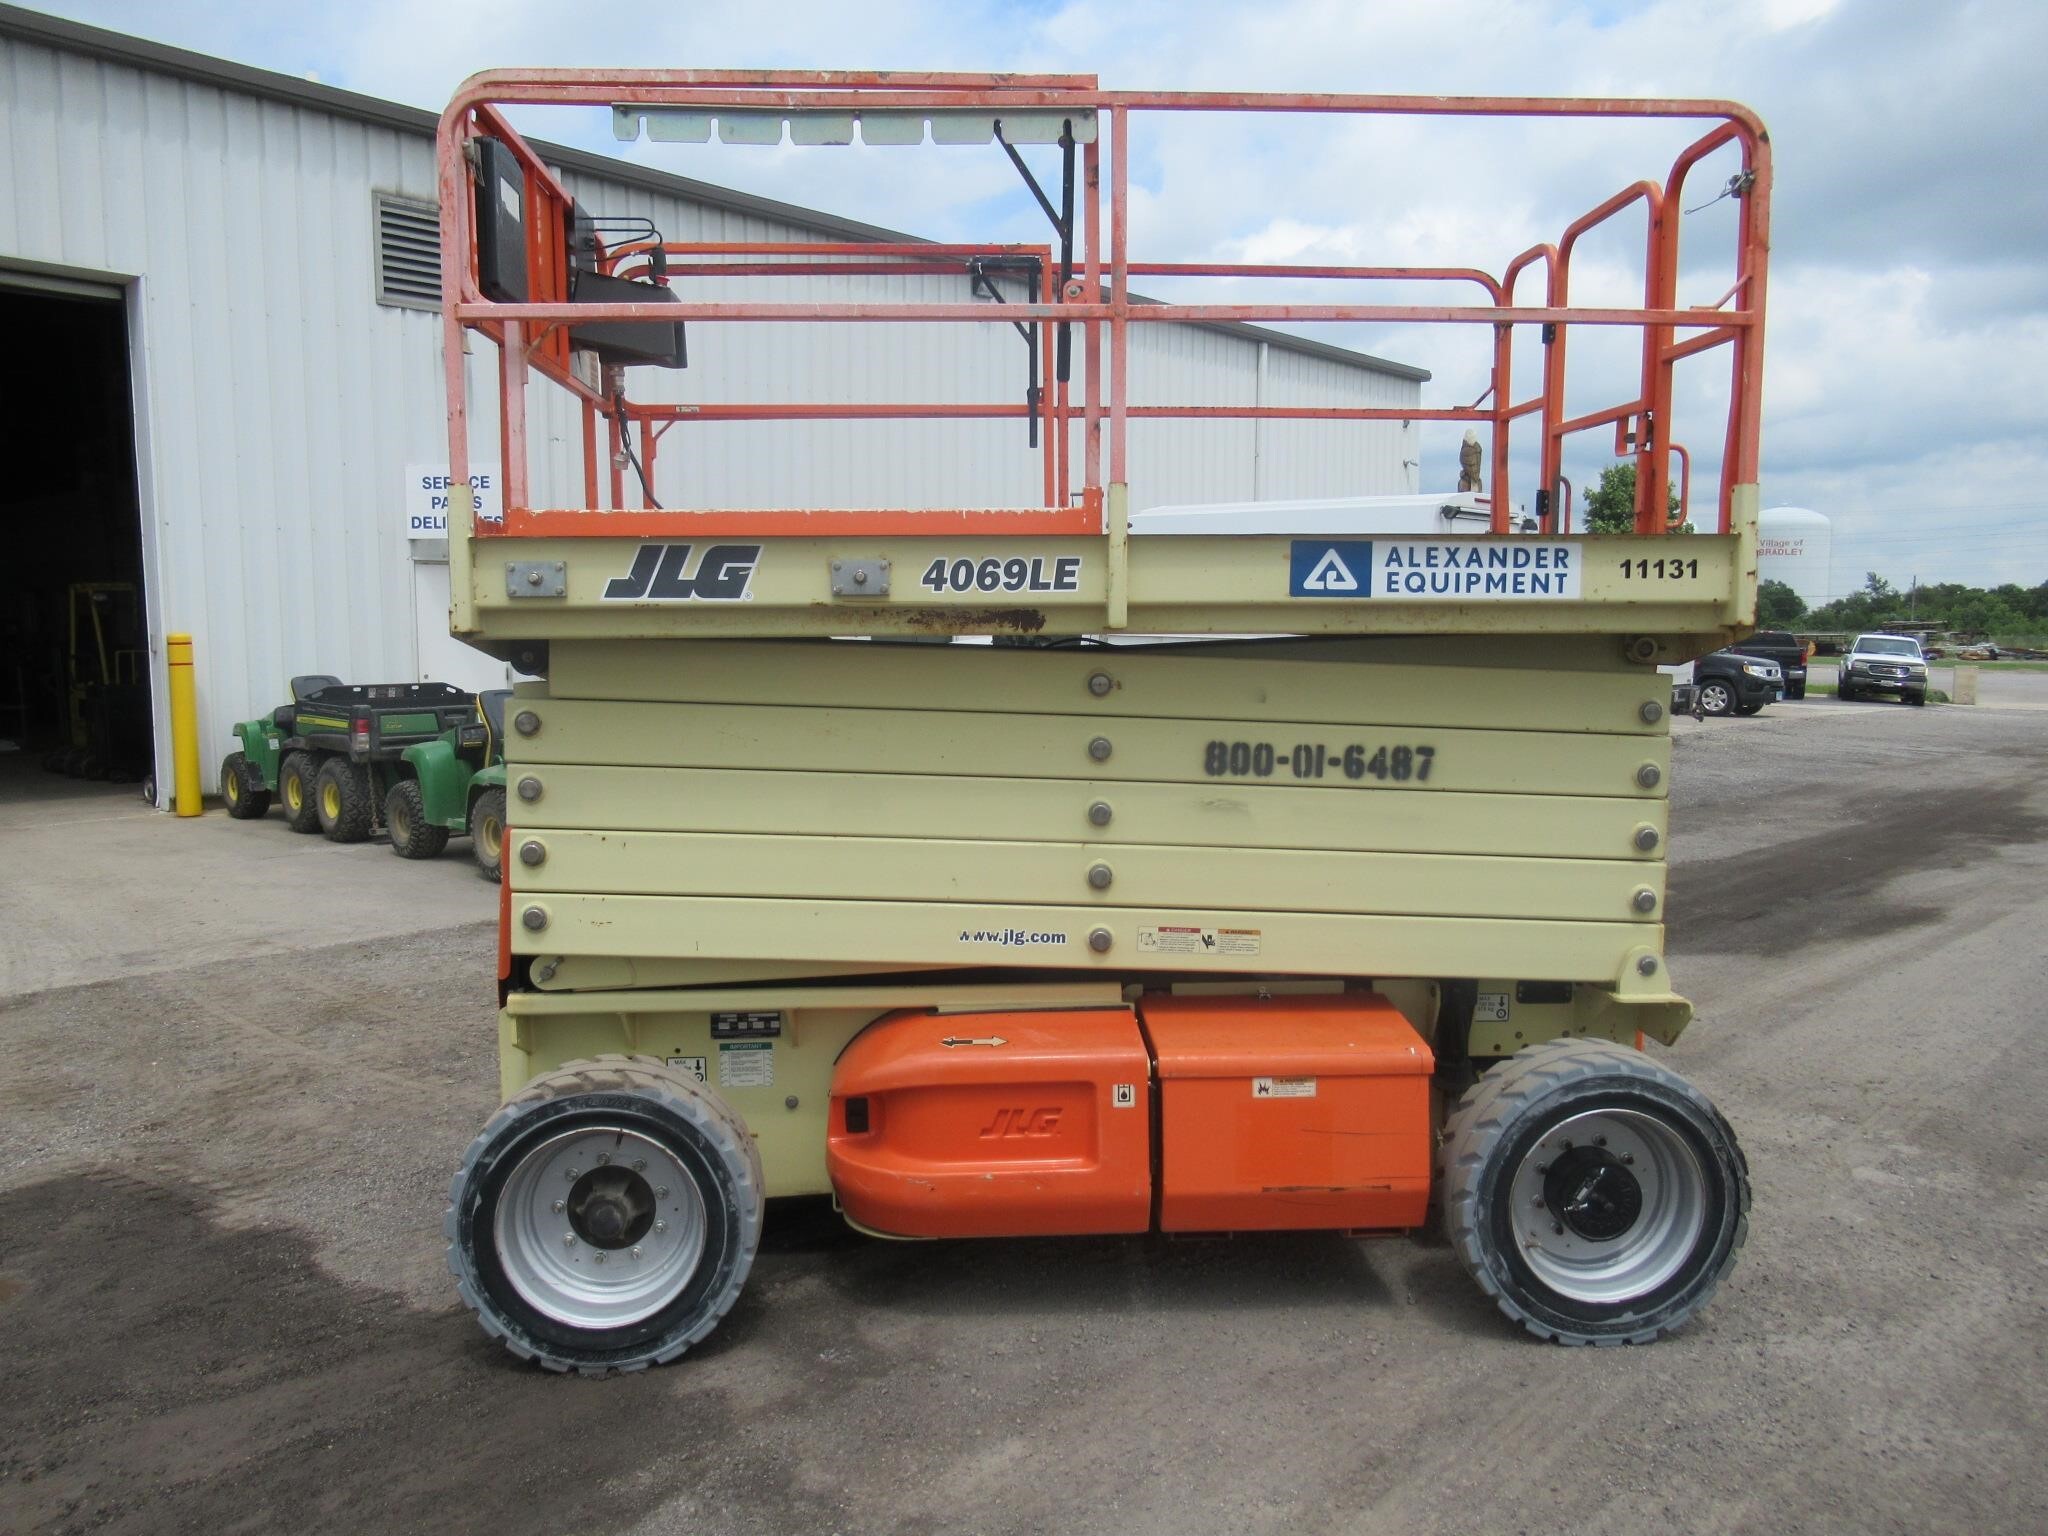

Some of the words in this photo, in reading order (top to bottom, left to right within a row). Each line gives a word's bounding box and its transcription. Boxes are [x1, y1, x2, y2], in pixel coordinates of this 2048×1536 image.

[422, 475, 490, 490] SERCE
[431, 495, 483, 510] PAS
[1759, 539, 1791, 548] Village
[1793, 539, 1804, 547] of
[1385, 546, 1569, 569] ALEXANDER
[1619, 558, 1698, 579] 11131
[602, 544, 763, 600] JLG
[921, 557, 1081, 593] 4069LE
[1386, 571, 1568, 594] EQUIPMENT
[1204, 740, 1435, 782] 800-01-6487
[979, 1107, 1064, 1139] JLG
